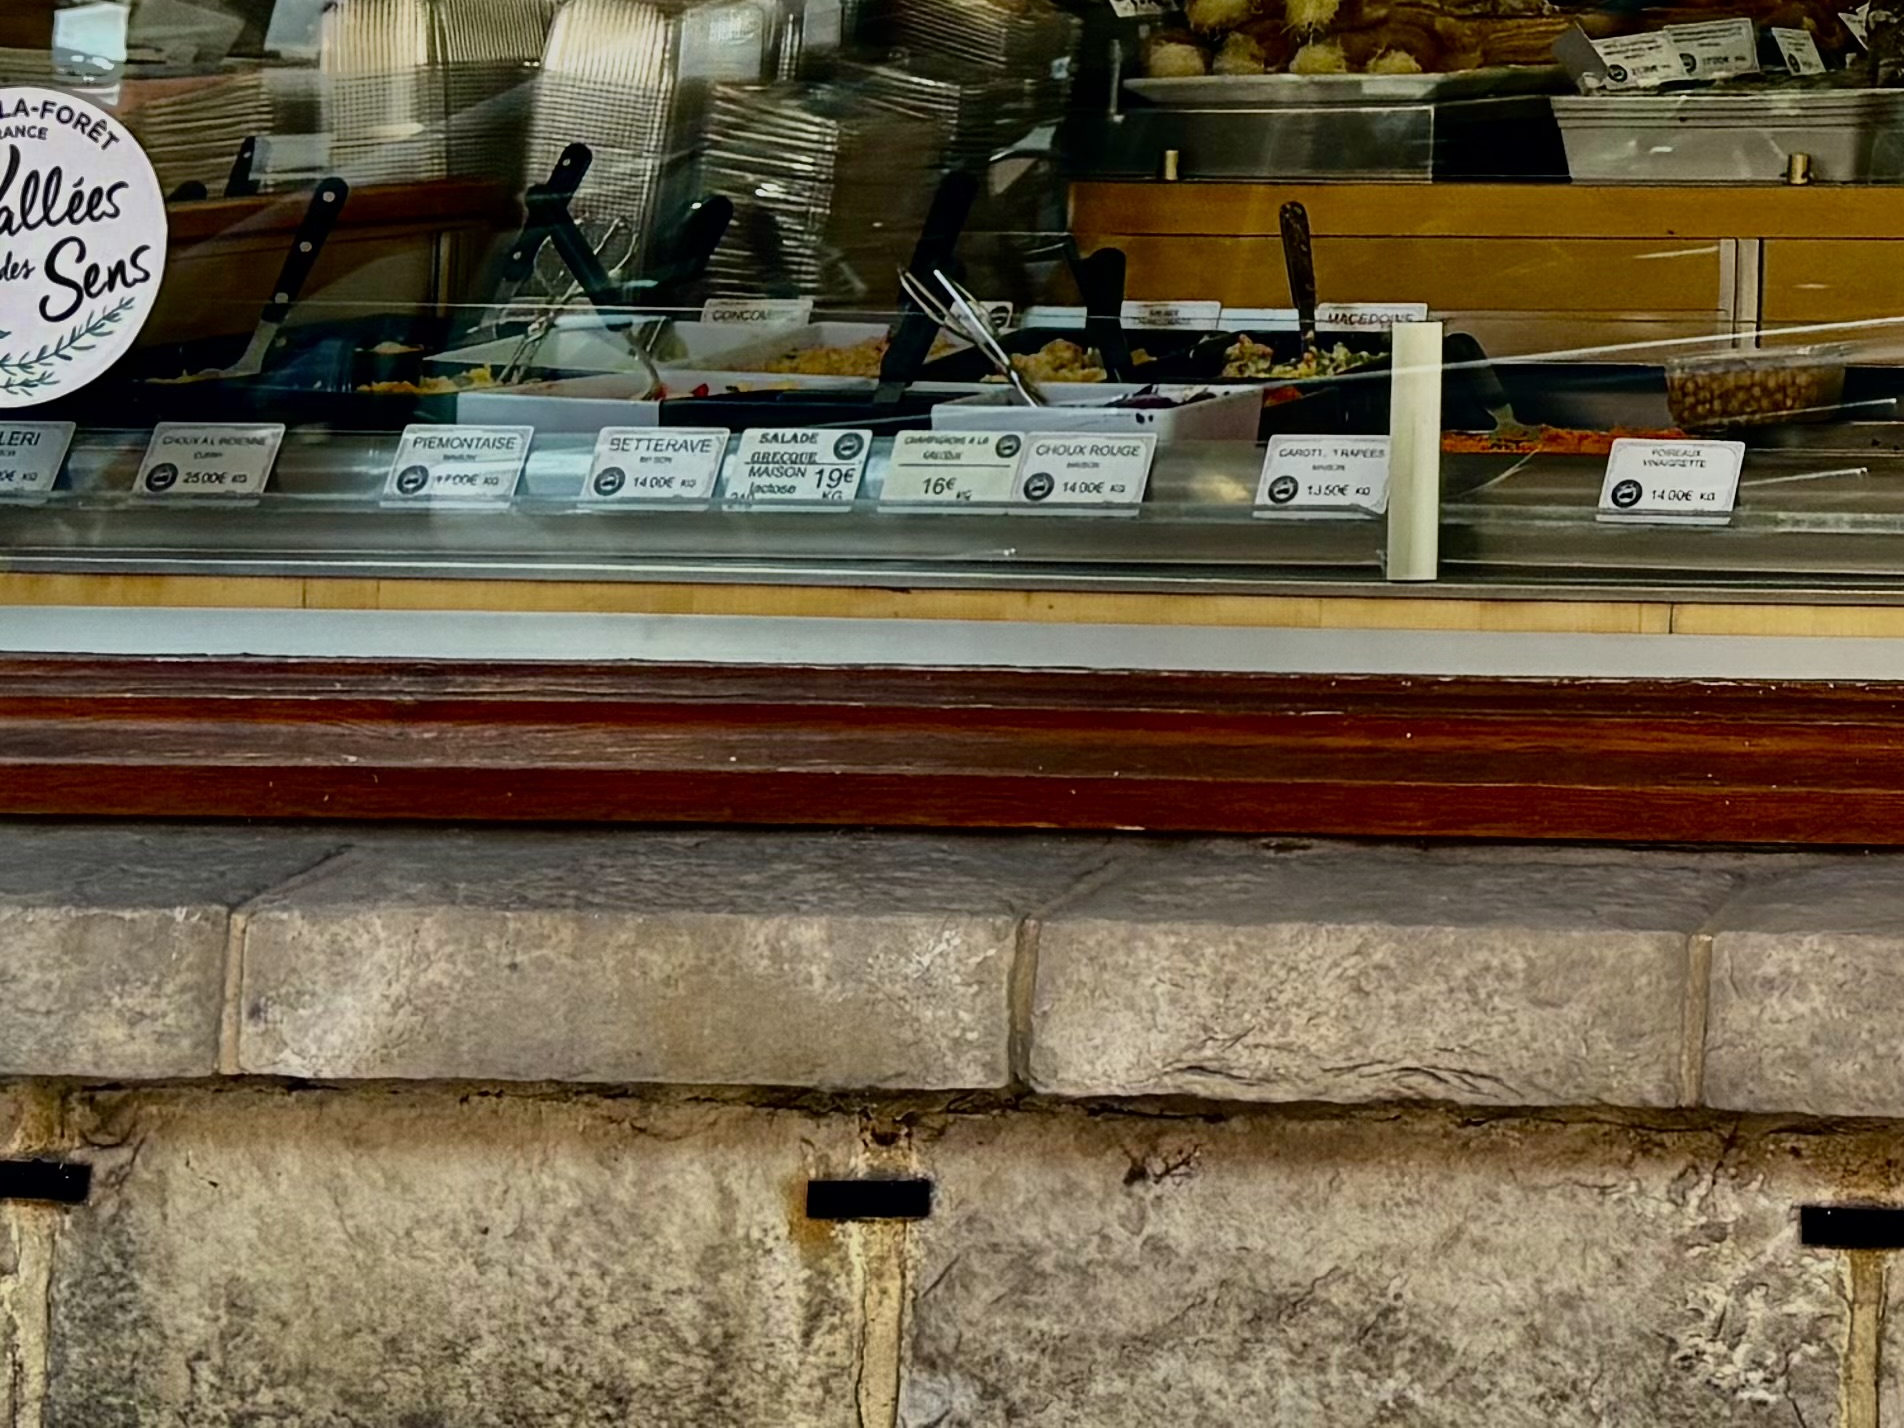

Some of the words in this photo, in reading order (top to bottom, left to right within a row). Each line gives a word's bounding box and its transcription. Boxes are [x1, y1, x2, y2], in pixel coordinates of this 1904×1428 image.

[39, 236, 151, 323] Sens
[413, 436, 518, 452] PIEMONTAISE
[609, 437, 713, 454] BETTERAVE
[758, 432, 819, 444] SALADE
[1035, 444, 1087, 457] CHOUX
[1089, 444, 1141, 457] ROUGE
[748, 465, 807, 479] MAISON
[814, 467, 856, 489] 19€
[922, 476, 957, 495] 16€
